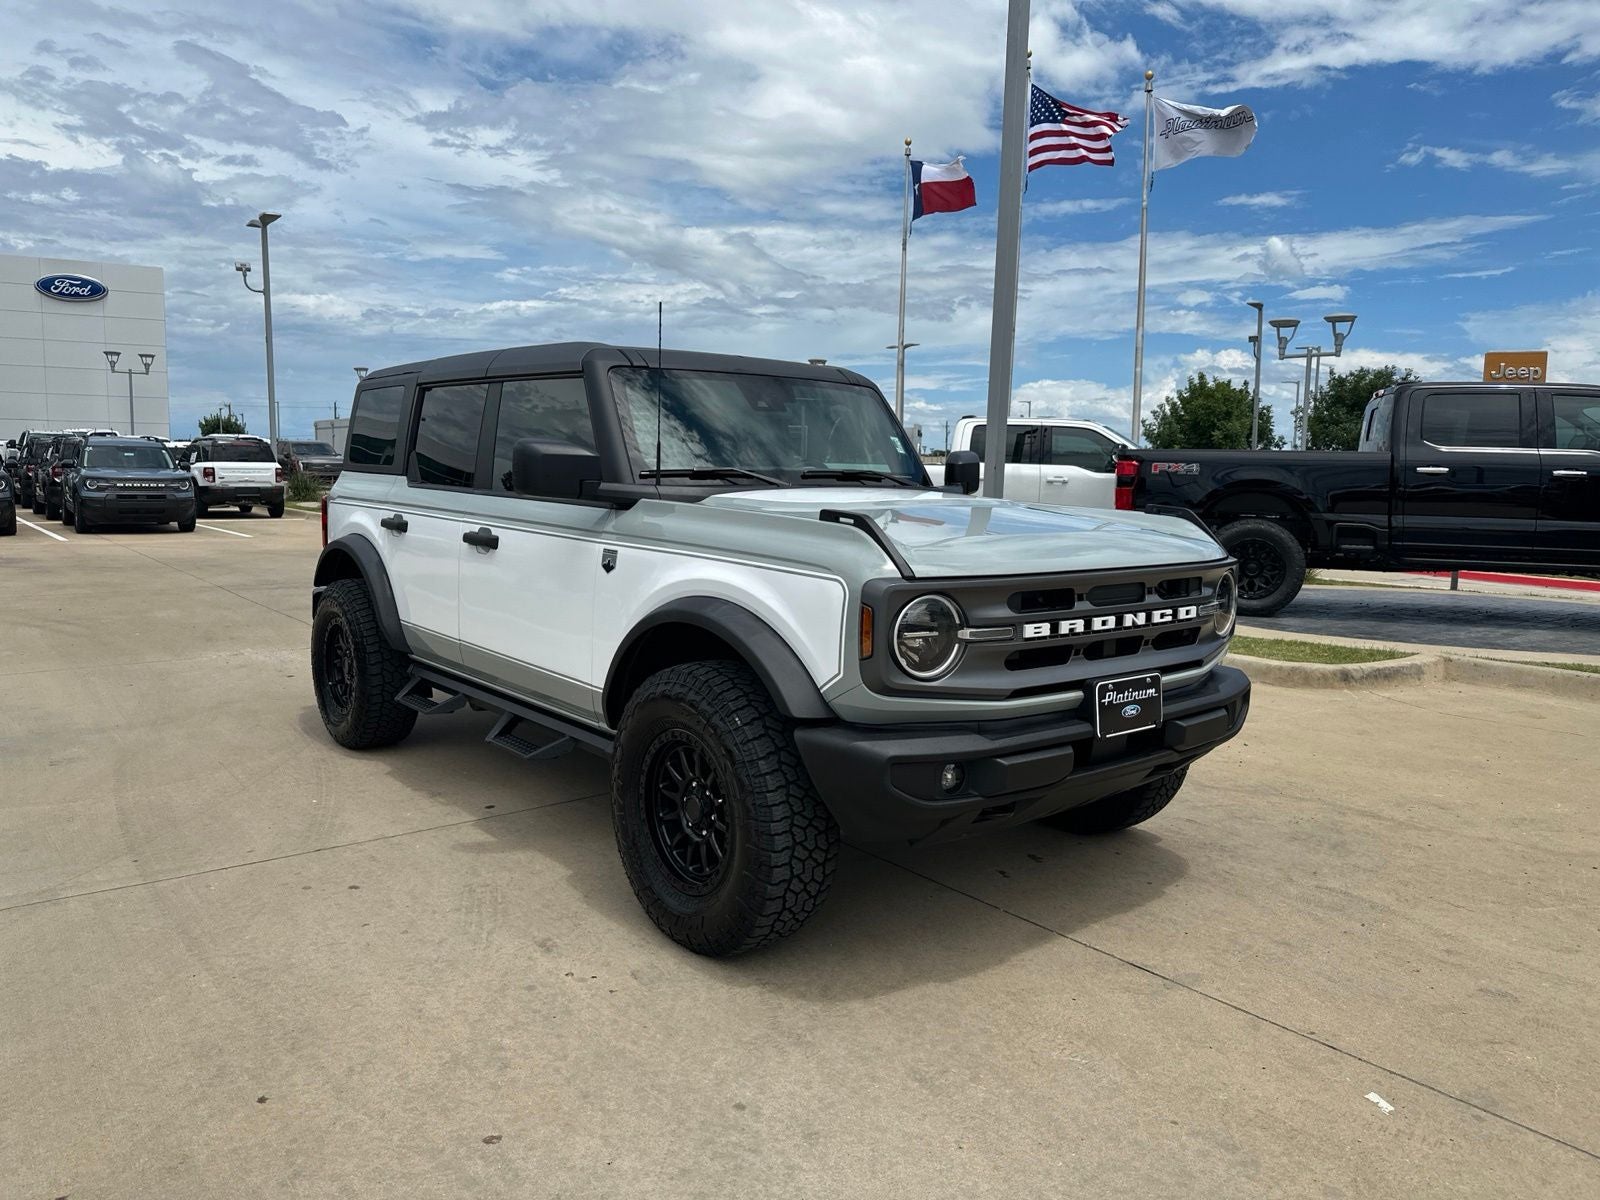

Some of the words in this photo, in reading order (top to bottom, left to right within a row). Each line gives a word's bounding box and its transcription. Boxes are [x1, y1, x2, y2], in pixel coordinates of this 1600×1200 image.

[50, 278, 92, 296] Ford
[1490, 362, 1542, 382] Jeep
[1151, 462, 1200, 474] FX4
[1022, 605, 1198, 639] BRONCO
[1100, 687, 1159, 706] Platinum
